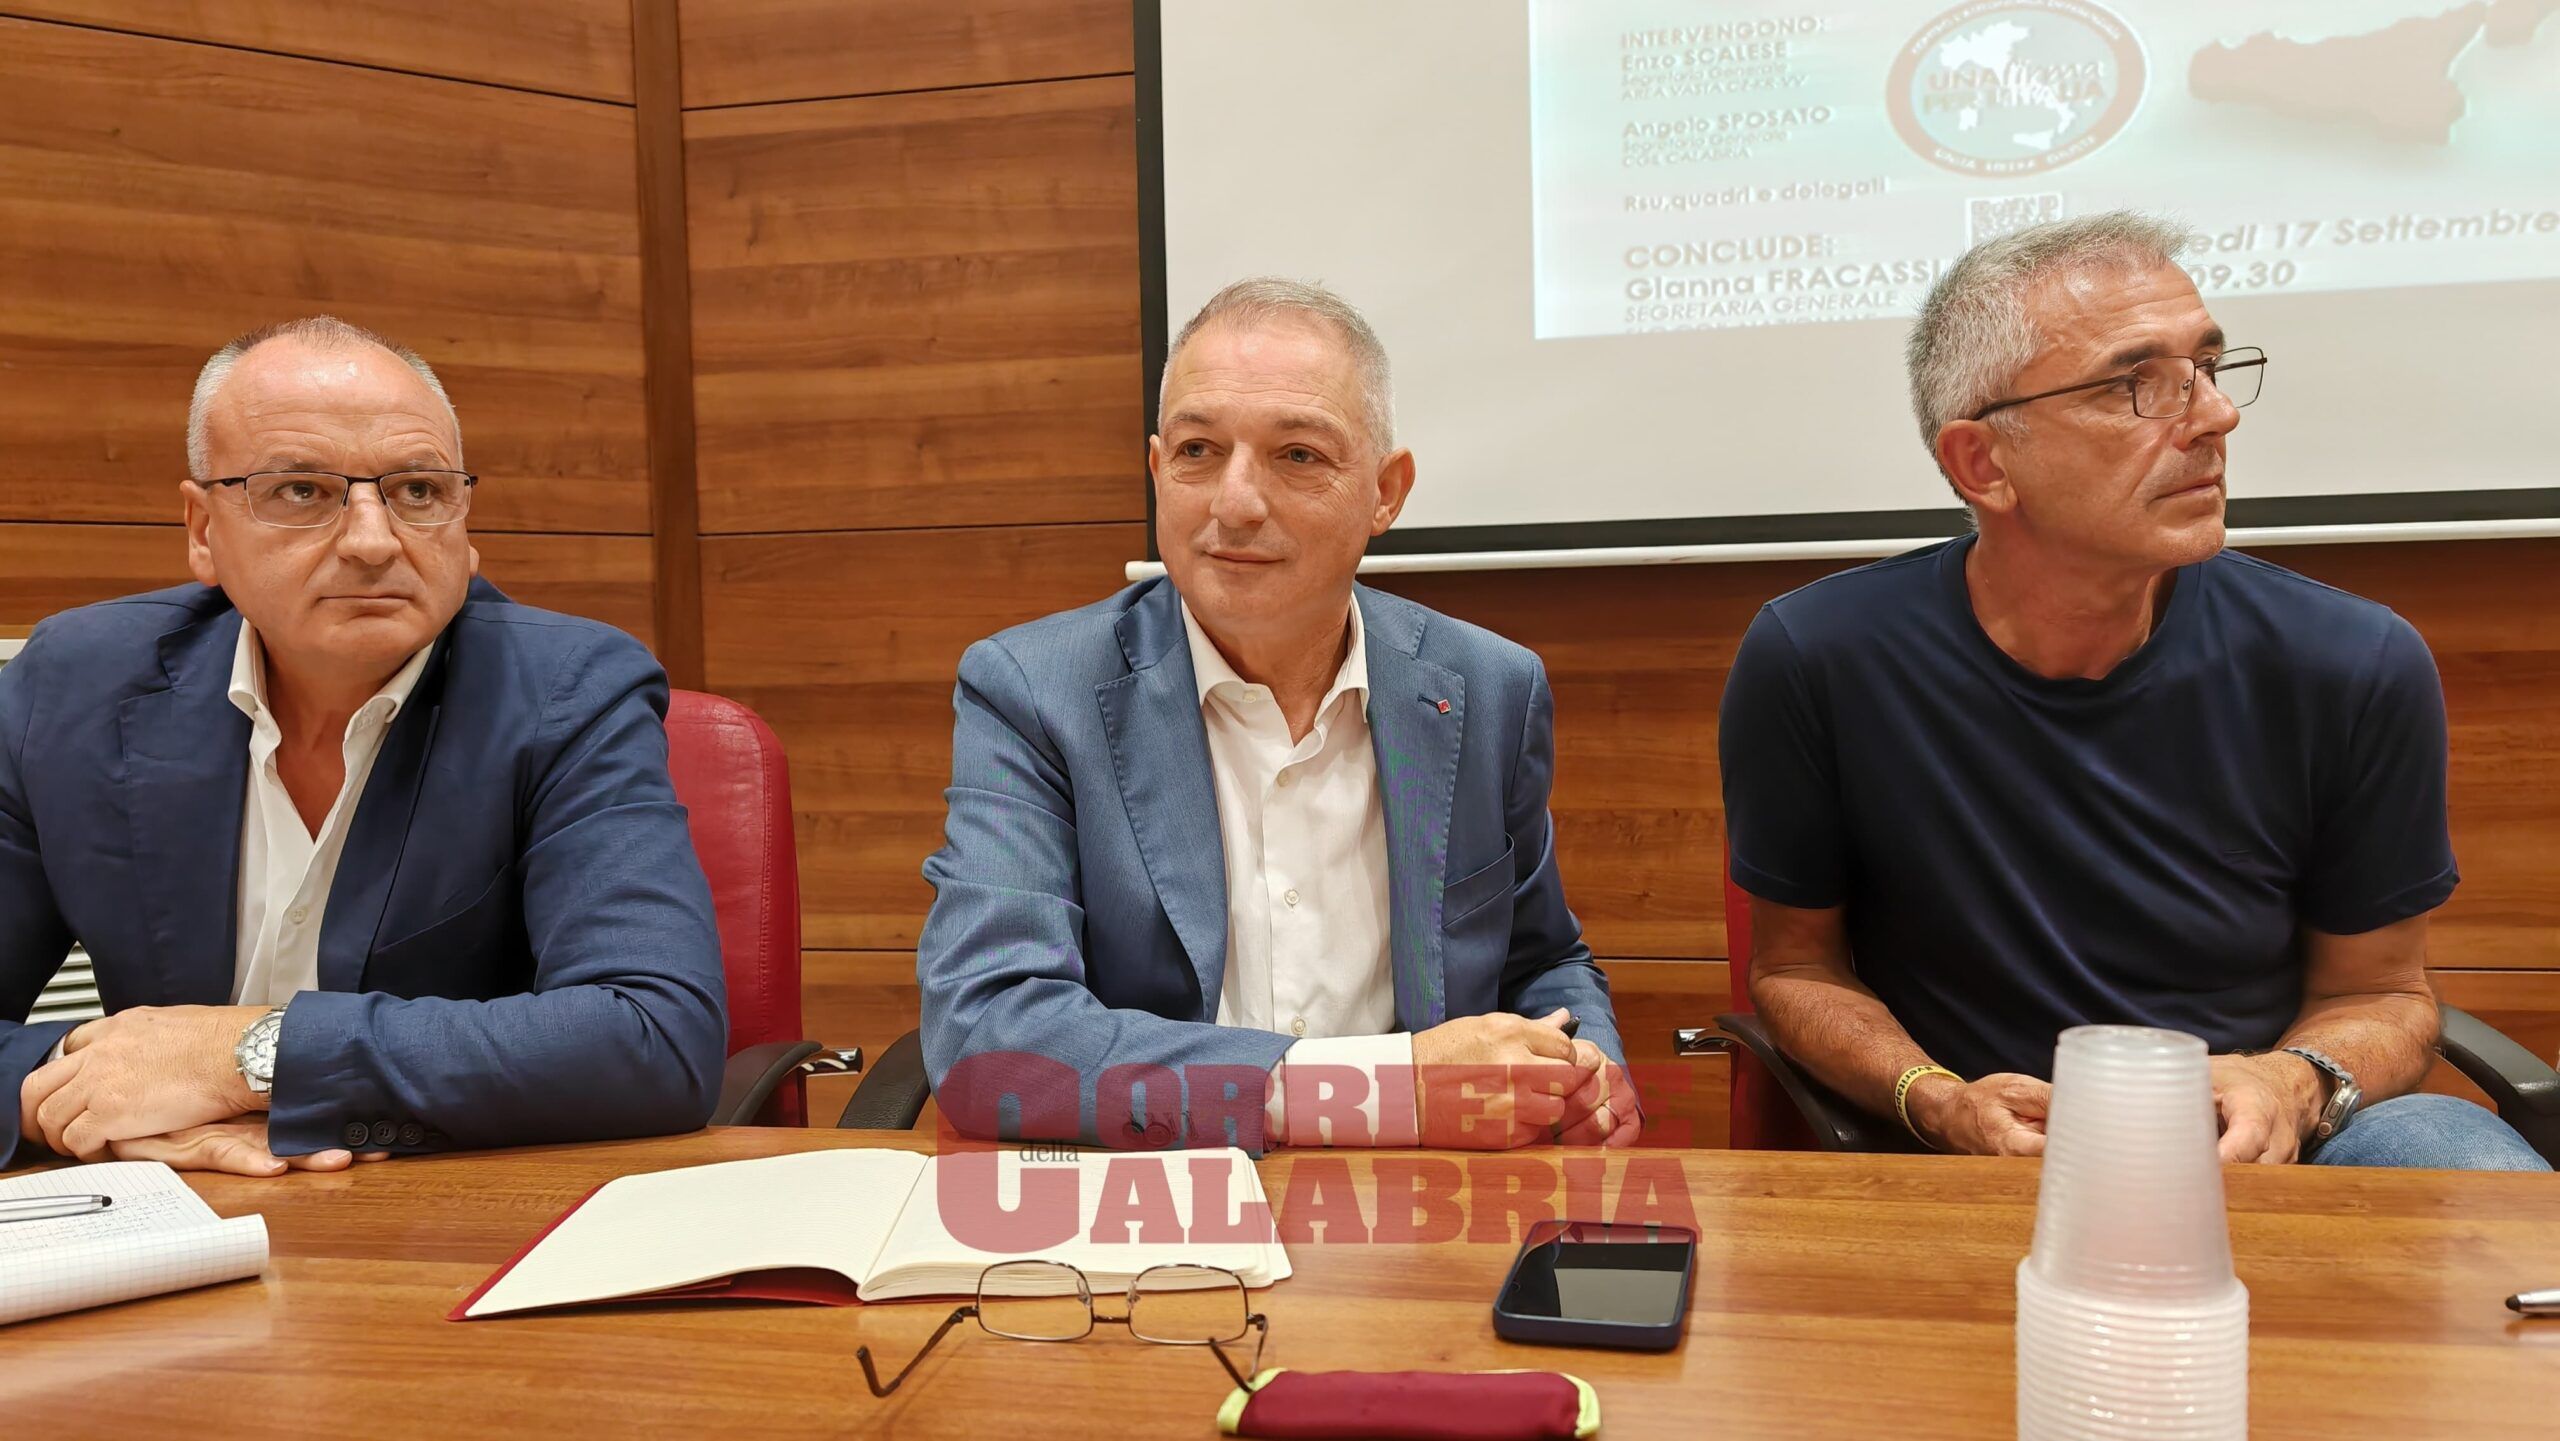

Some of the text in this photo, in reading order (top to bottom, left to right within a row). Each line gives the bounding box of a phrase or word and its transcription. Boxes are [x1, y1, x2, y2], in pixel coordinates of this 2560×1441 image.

[1621, 16, 1828, 49] INTERVENGONO:
[1622, 41, 1788, 72] Enzo SCALESE
[1927, 66, 2000, 92] UNA
[1623, 105, 1832, 139] Angelo SPOSATO
[1756, 186, 1772, 203] e
[1780, 175, 1886, 202] delegati
[2272, 219, 2324, 251] 17
[2331, 207, 2560, 247] Settembre
[1625, 234, 1834, 270] CONCLUDE:
[1625, 259, 1942, 302] Gianna FRACASSI
[1624, 298, 1765, 324] SEGRETARIA
[1771, 289, 1899, 315] GENERALE
